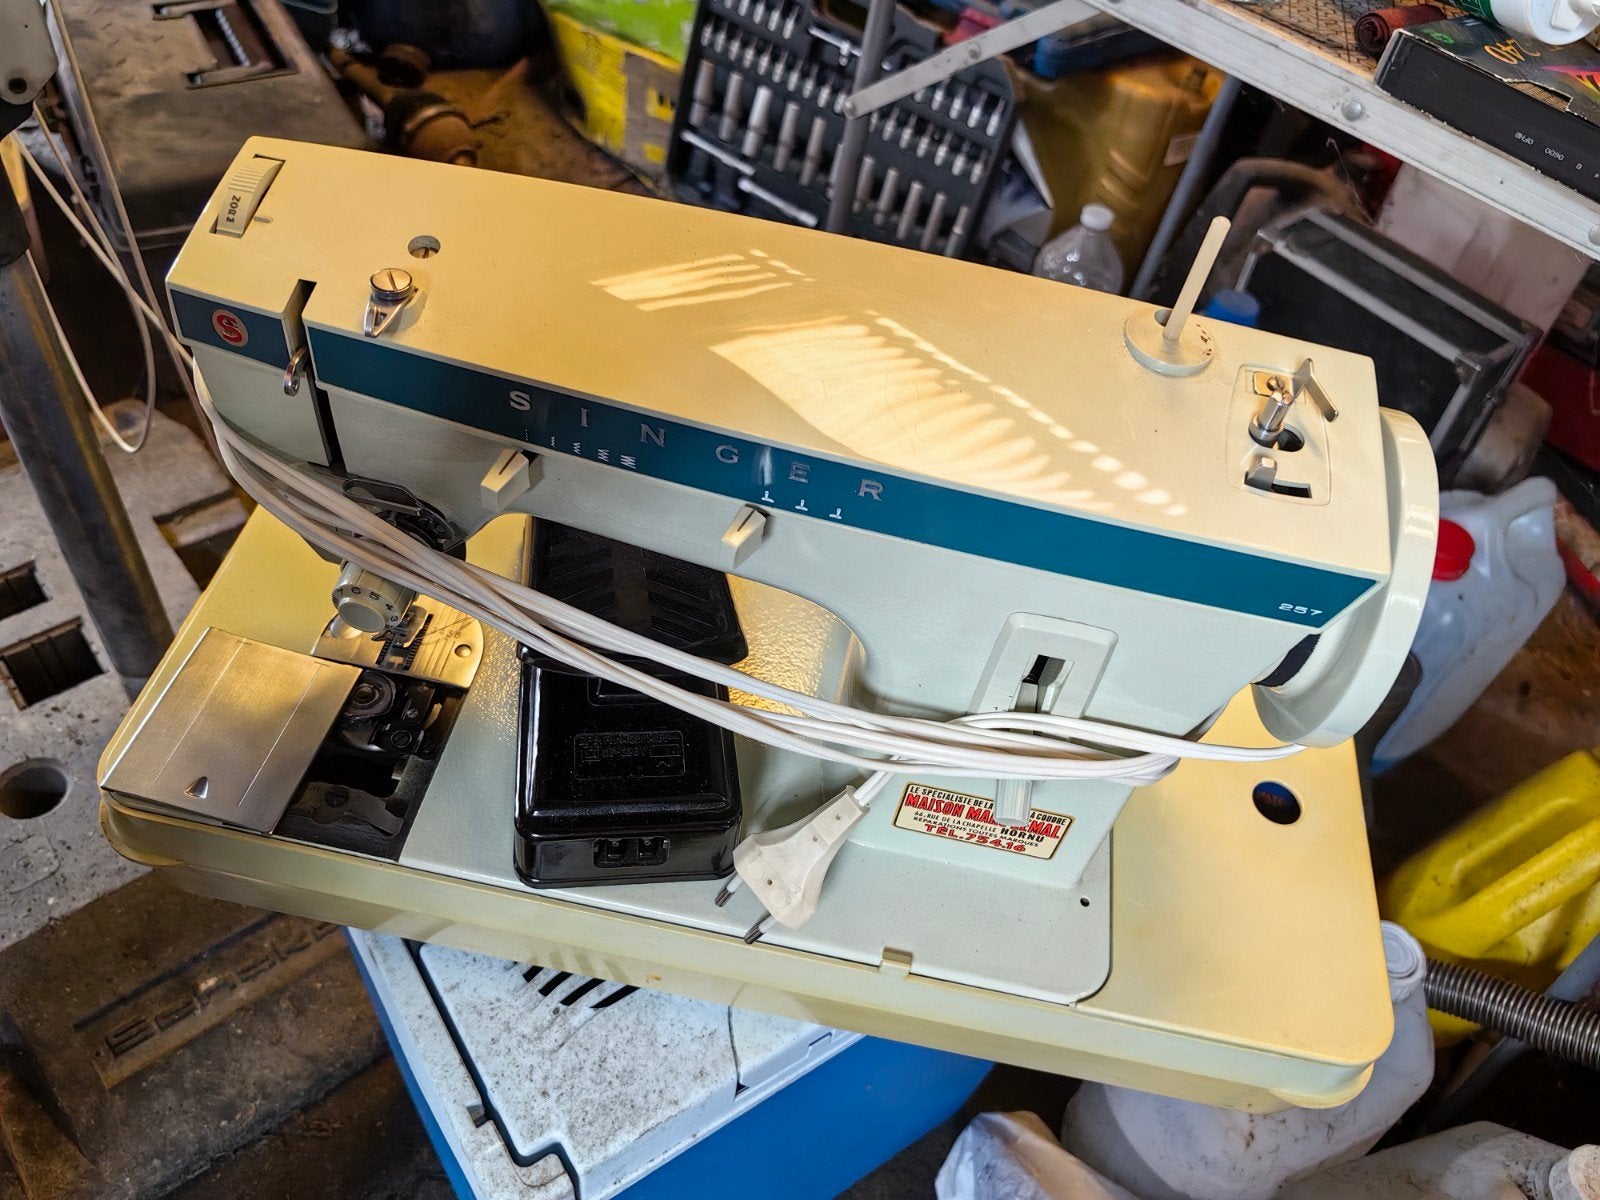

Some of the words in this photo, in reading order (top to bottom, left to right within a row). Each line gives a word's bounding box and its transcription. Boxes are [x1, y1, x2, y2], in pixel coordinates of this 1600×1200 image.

[1279, 603, 1323, 616] 257
[904, 793, 966, 818] MAISON
[909, 785, 920, 794] LE
[973, 798, 984, 808] DE
[983, 800, 994, 810] LA
[1035, 813, 1067, 826] COUDRE
[926, 813, 939, 822] RUE
[941, 816, 951, 824] DE
[952, 818, 962, 826] LA
[961, 820, 998, 833] CHAPELLE
[999, 827, 1045, 843] HORNU
[968, 828, 998, 839] TOUTES
[999, 835, 1039, 848] MARQUES
